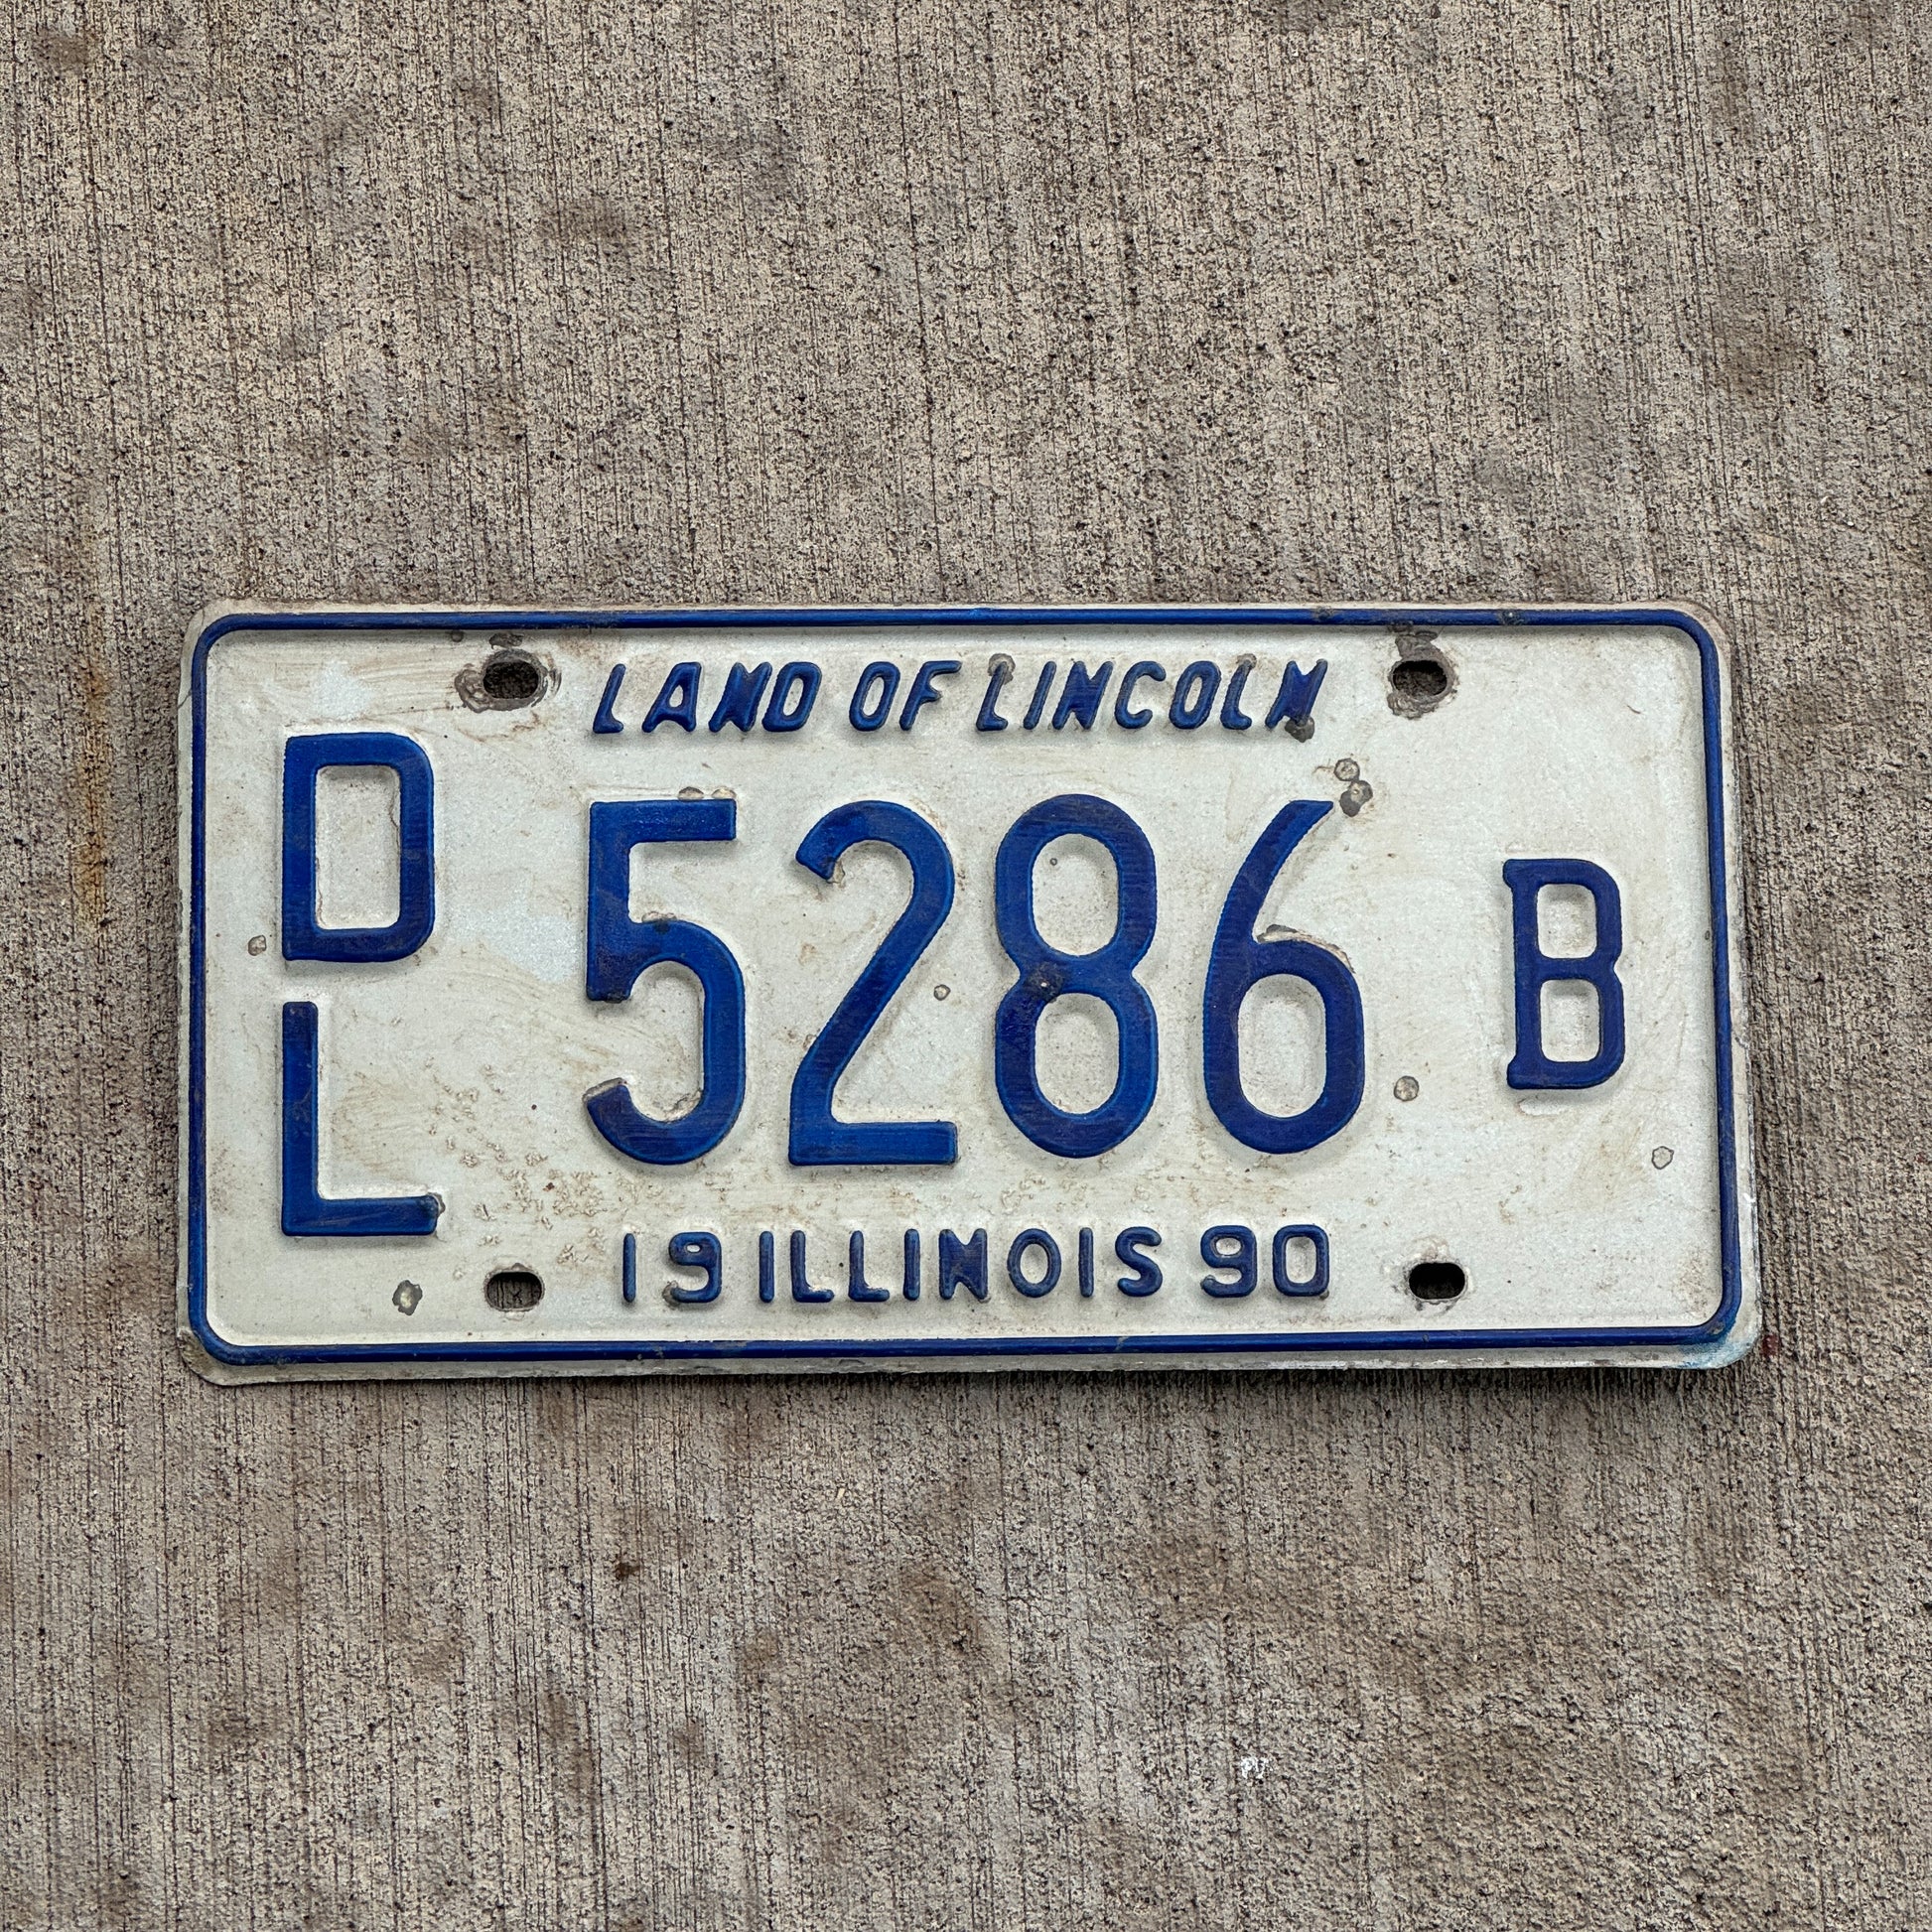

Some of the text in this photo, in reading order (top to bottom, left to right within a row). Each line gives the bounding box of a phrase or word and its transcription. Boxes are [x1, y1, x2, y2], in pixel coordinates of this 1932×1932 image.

[592, 659, 1329, 734] LAND OF LINCOLN
[584, 793, 1365, 1167] 5286
[1502, 858, 1626, 1091] B
[621, 1224, 1330, 1305] 19 ILLINOIS 90
